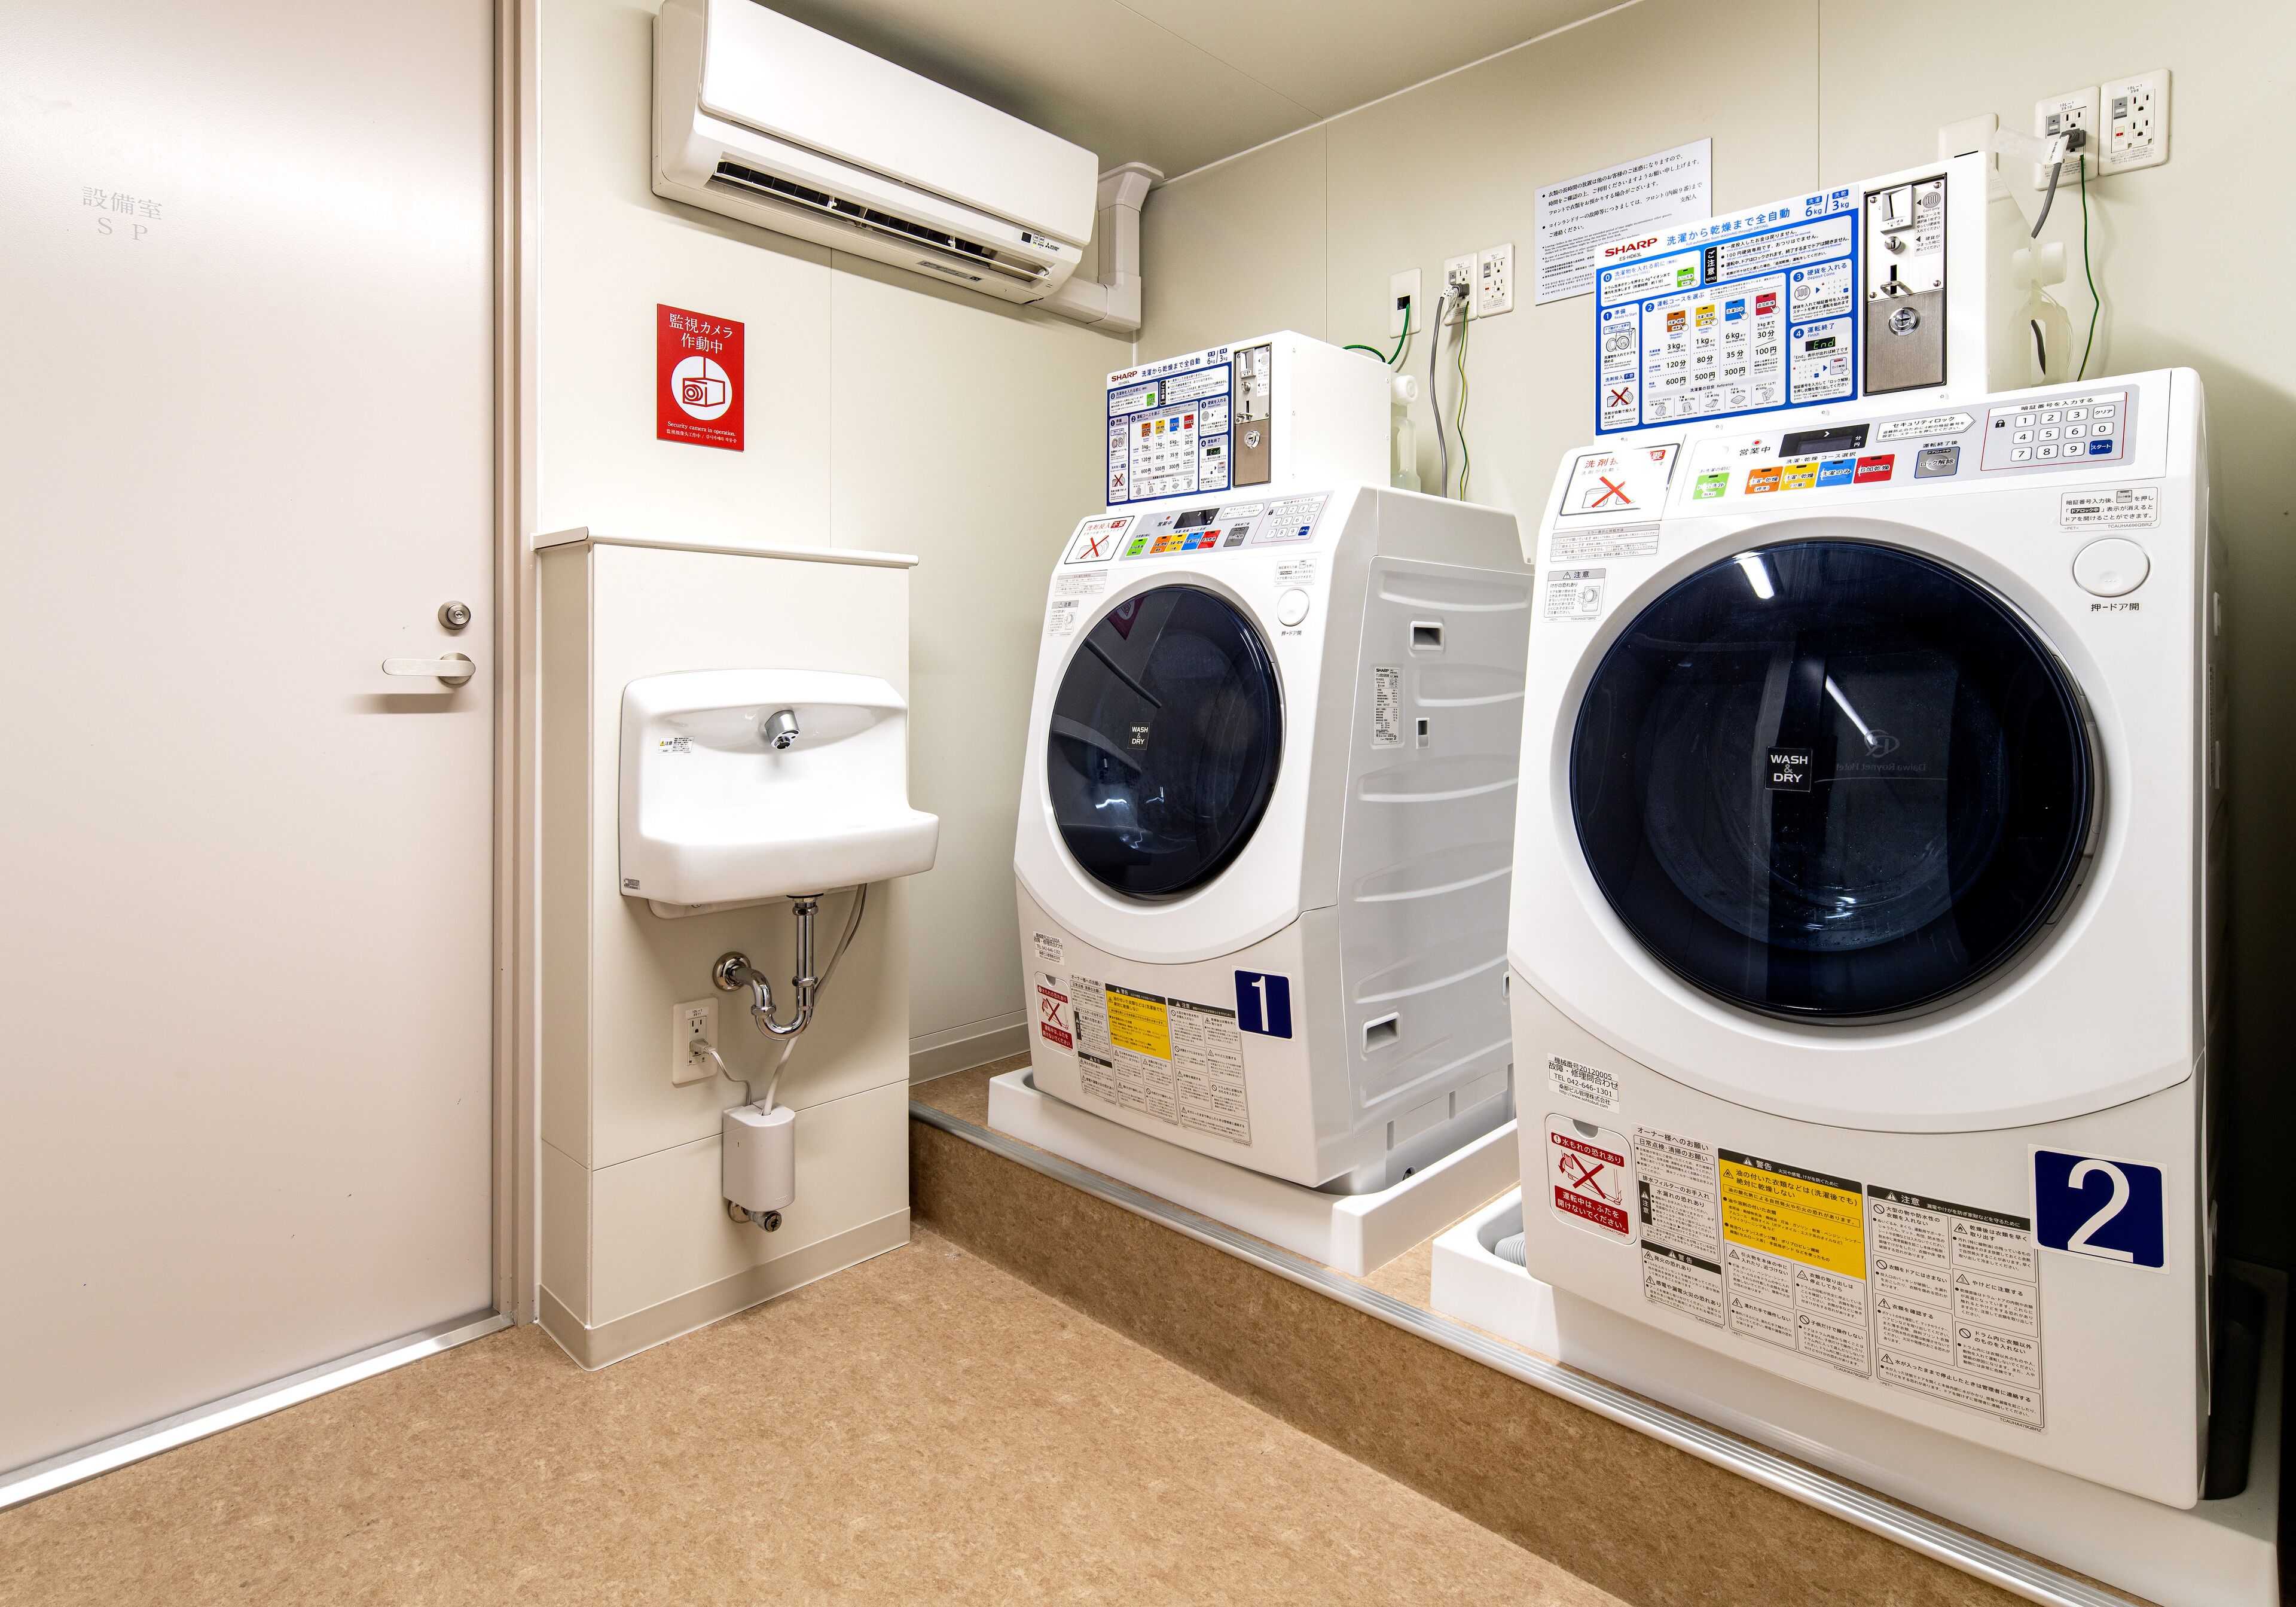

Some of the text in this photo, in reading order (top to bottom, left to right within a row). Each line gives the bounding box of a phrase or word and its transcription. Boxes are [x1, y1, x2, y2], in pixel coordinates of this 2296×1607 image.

[82, 187, 162, 220] 設備室
[1680, 194, 1697, 203] 支配人
[1549, 225, 1584, 237] ご連絡ください。
[1667, 208, 1790, 246] 洗濯から乾燥まで全自動
[1605, 238, 1657, 257] SHARP
[1615, 260, 1665, 276] 洗濯物を入れる前に
[1706, 250, 1715, 276] ご注意
[1808, 263, 1847, 276] 硬貨を入れる
[1657, 292, 1705, 307] 運転コースを選ぶ
[1793, 295, 1849, 309] 硬貨を入れて暗証番号を入力後
[669, 313, 732, 338] 監視カメラ
[1808, 323, 1834, 333] 運転終了
[681, 333, 722, 353] 作動中
[1813, 338, 1834, 349] End
[1142, 358, 1201, 377] 洗濯から乾燥まで全自動
[1112, 371, 1137, 382] SHARP
[2021, 398, 2093, 410] 暗証番号を入力する
[667, 421, 688, 429] Security
[1893, 417, 1955, 428] セキュリティロック
[1739, 446, 1770, 456] 営業中
[1821, 452, 1856, 460] コース選択
[2066, 513, 2152, 522] ドアを開けることができます。
[1770, 755, 1808, 764] WASH
[1773, 773, 1803, 783] DRY
[1251, 975, 1269, 1032] 1
[1554, 1073, 1612, 1097] TEL 042-646-1301
[1638, 1127, 1709, 1151] オーナー様へのお願い
[1562, 1139, 1621, 1164] 水もれの恐れあり
[1757, 1160, 1772, 1171] 警告
[1642, 1175, 1710, 1200] 排水フィルターのお手入れ
[1736, 1177, 1795, 1199] 絶対に乾燥しない
[1563, 1191, 1619, 1218] 運転中は、ふたを
[1657, 1189, 1704, 1207] 水漏れの恐れあり
[1901, 1194, 1920, 1206] 注意
[1558, 1200, 1626, 1231] 開けないでください。
[1886, 1206, 1940, 1222] 大型の物や防水性の
[1886, 1212, 1928, 1225] 衣類を入れない
[2068, 1160, 2133, 1263] 2
[1970, 1225, 2028, 1242] 乾燥後は衣類を早く
[1970, 1232, 1995, 1241] 取り出す
[1654, 1255, 1692, 1272] 発火の恐れあり
[1677, 1254, 1693, 1264] 警告
[1741, 1252, 1788, 1270] 引火物を本体の中に
[1809, 1273, 1854, 1289] 衣類の取り出しは
[1889, 1264, 1947, 1283] 衣類をドアにはさまない
[1656, 1280, 1721, 1307] 感電や漏電火災の恐れあり
[1810, 1279, 1842, 1292] 停止してから
[1973, 1280, 2024, 1297] やけどに注意する
[1892, 1304, 1934, 1319] 衣類を確認する
[1810, 1320, 1863, 1340] 子供だけで操作しない
[1975, 1330, 2032, 1349] ドラム内に衣類以外
[1975, 1338, 2026, 1354] のものを入れない
